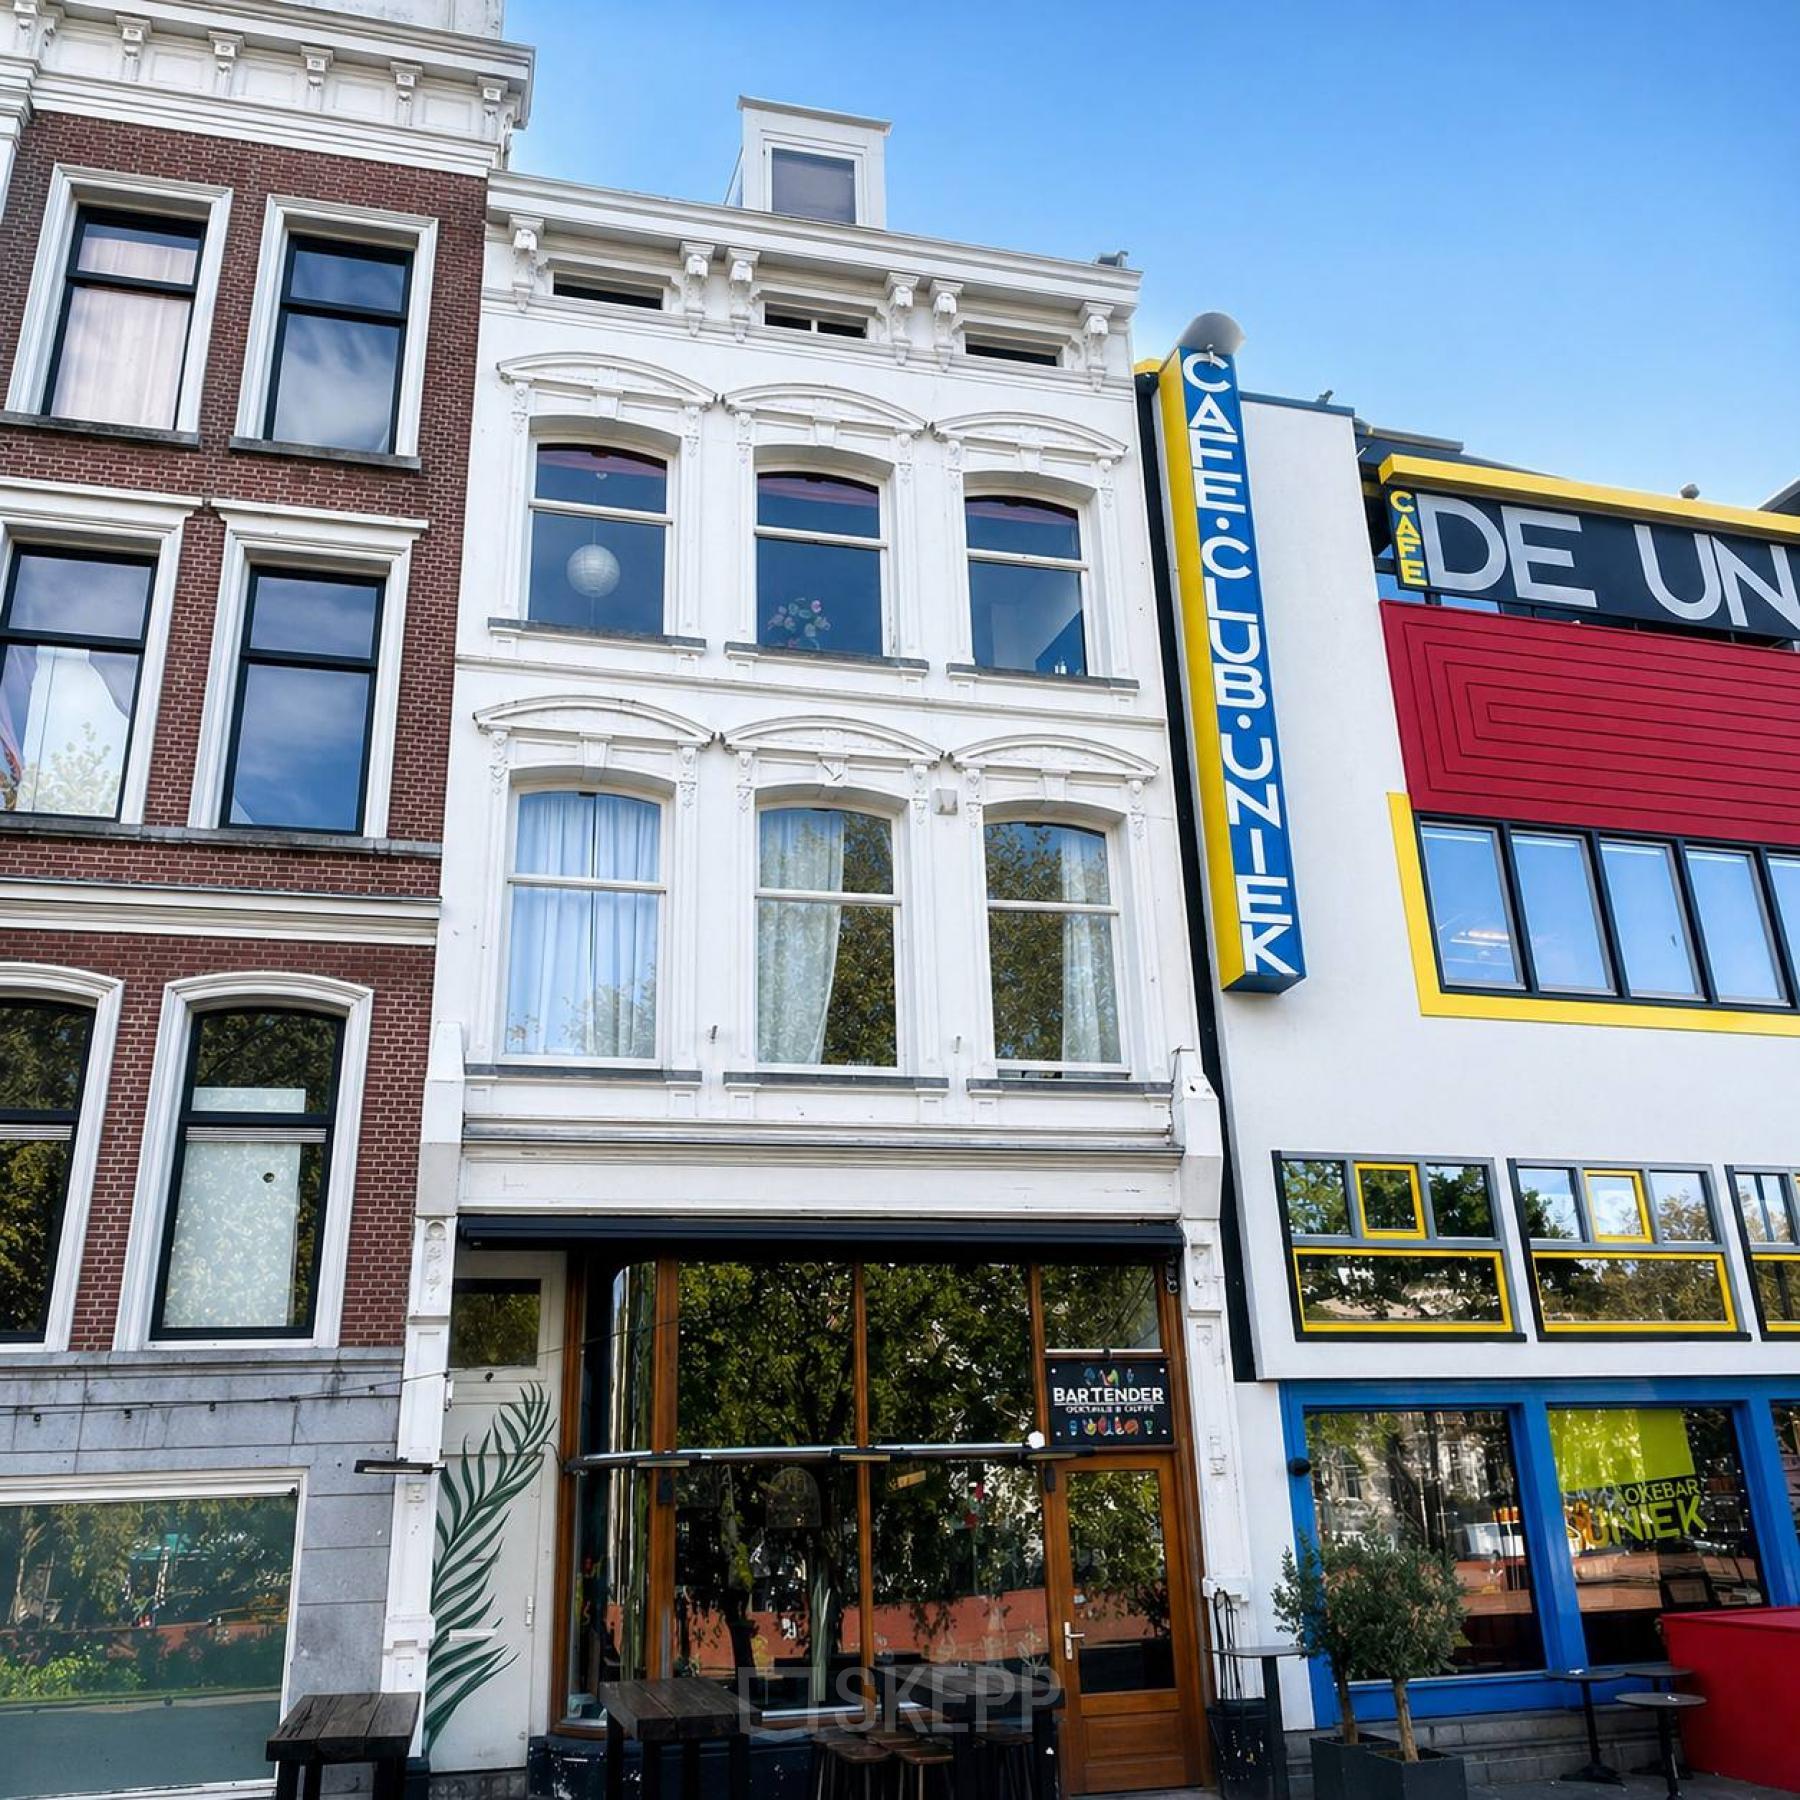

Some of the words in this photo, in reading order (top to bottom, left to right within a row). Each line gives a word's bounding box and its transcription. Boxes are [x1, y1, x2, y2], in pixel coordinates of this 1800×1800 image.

[1182, 353, 1247, 514] CAFE
[1390, 490, 1428, 586] CAFE
[1416, 493, 1598, 608] DE
[1200, 536, 1267, 709] CLUB
[1221, 733, 1299, 975] UNIEK
[1053, 1387, 1164, 1402] BARTENDER
[1582, 1495, 1707, 1548] UNIEK
